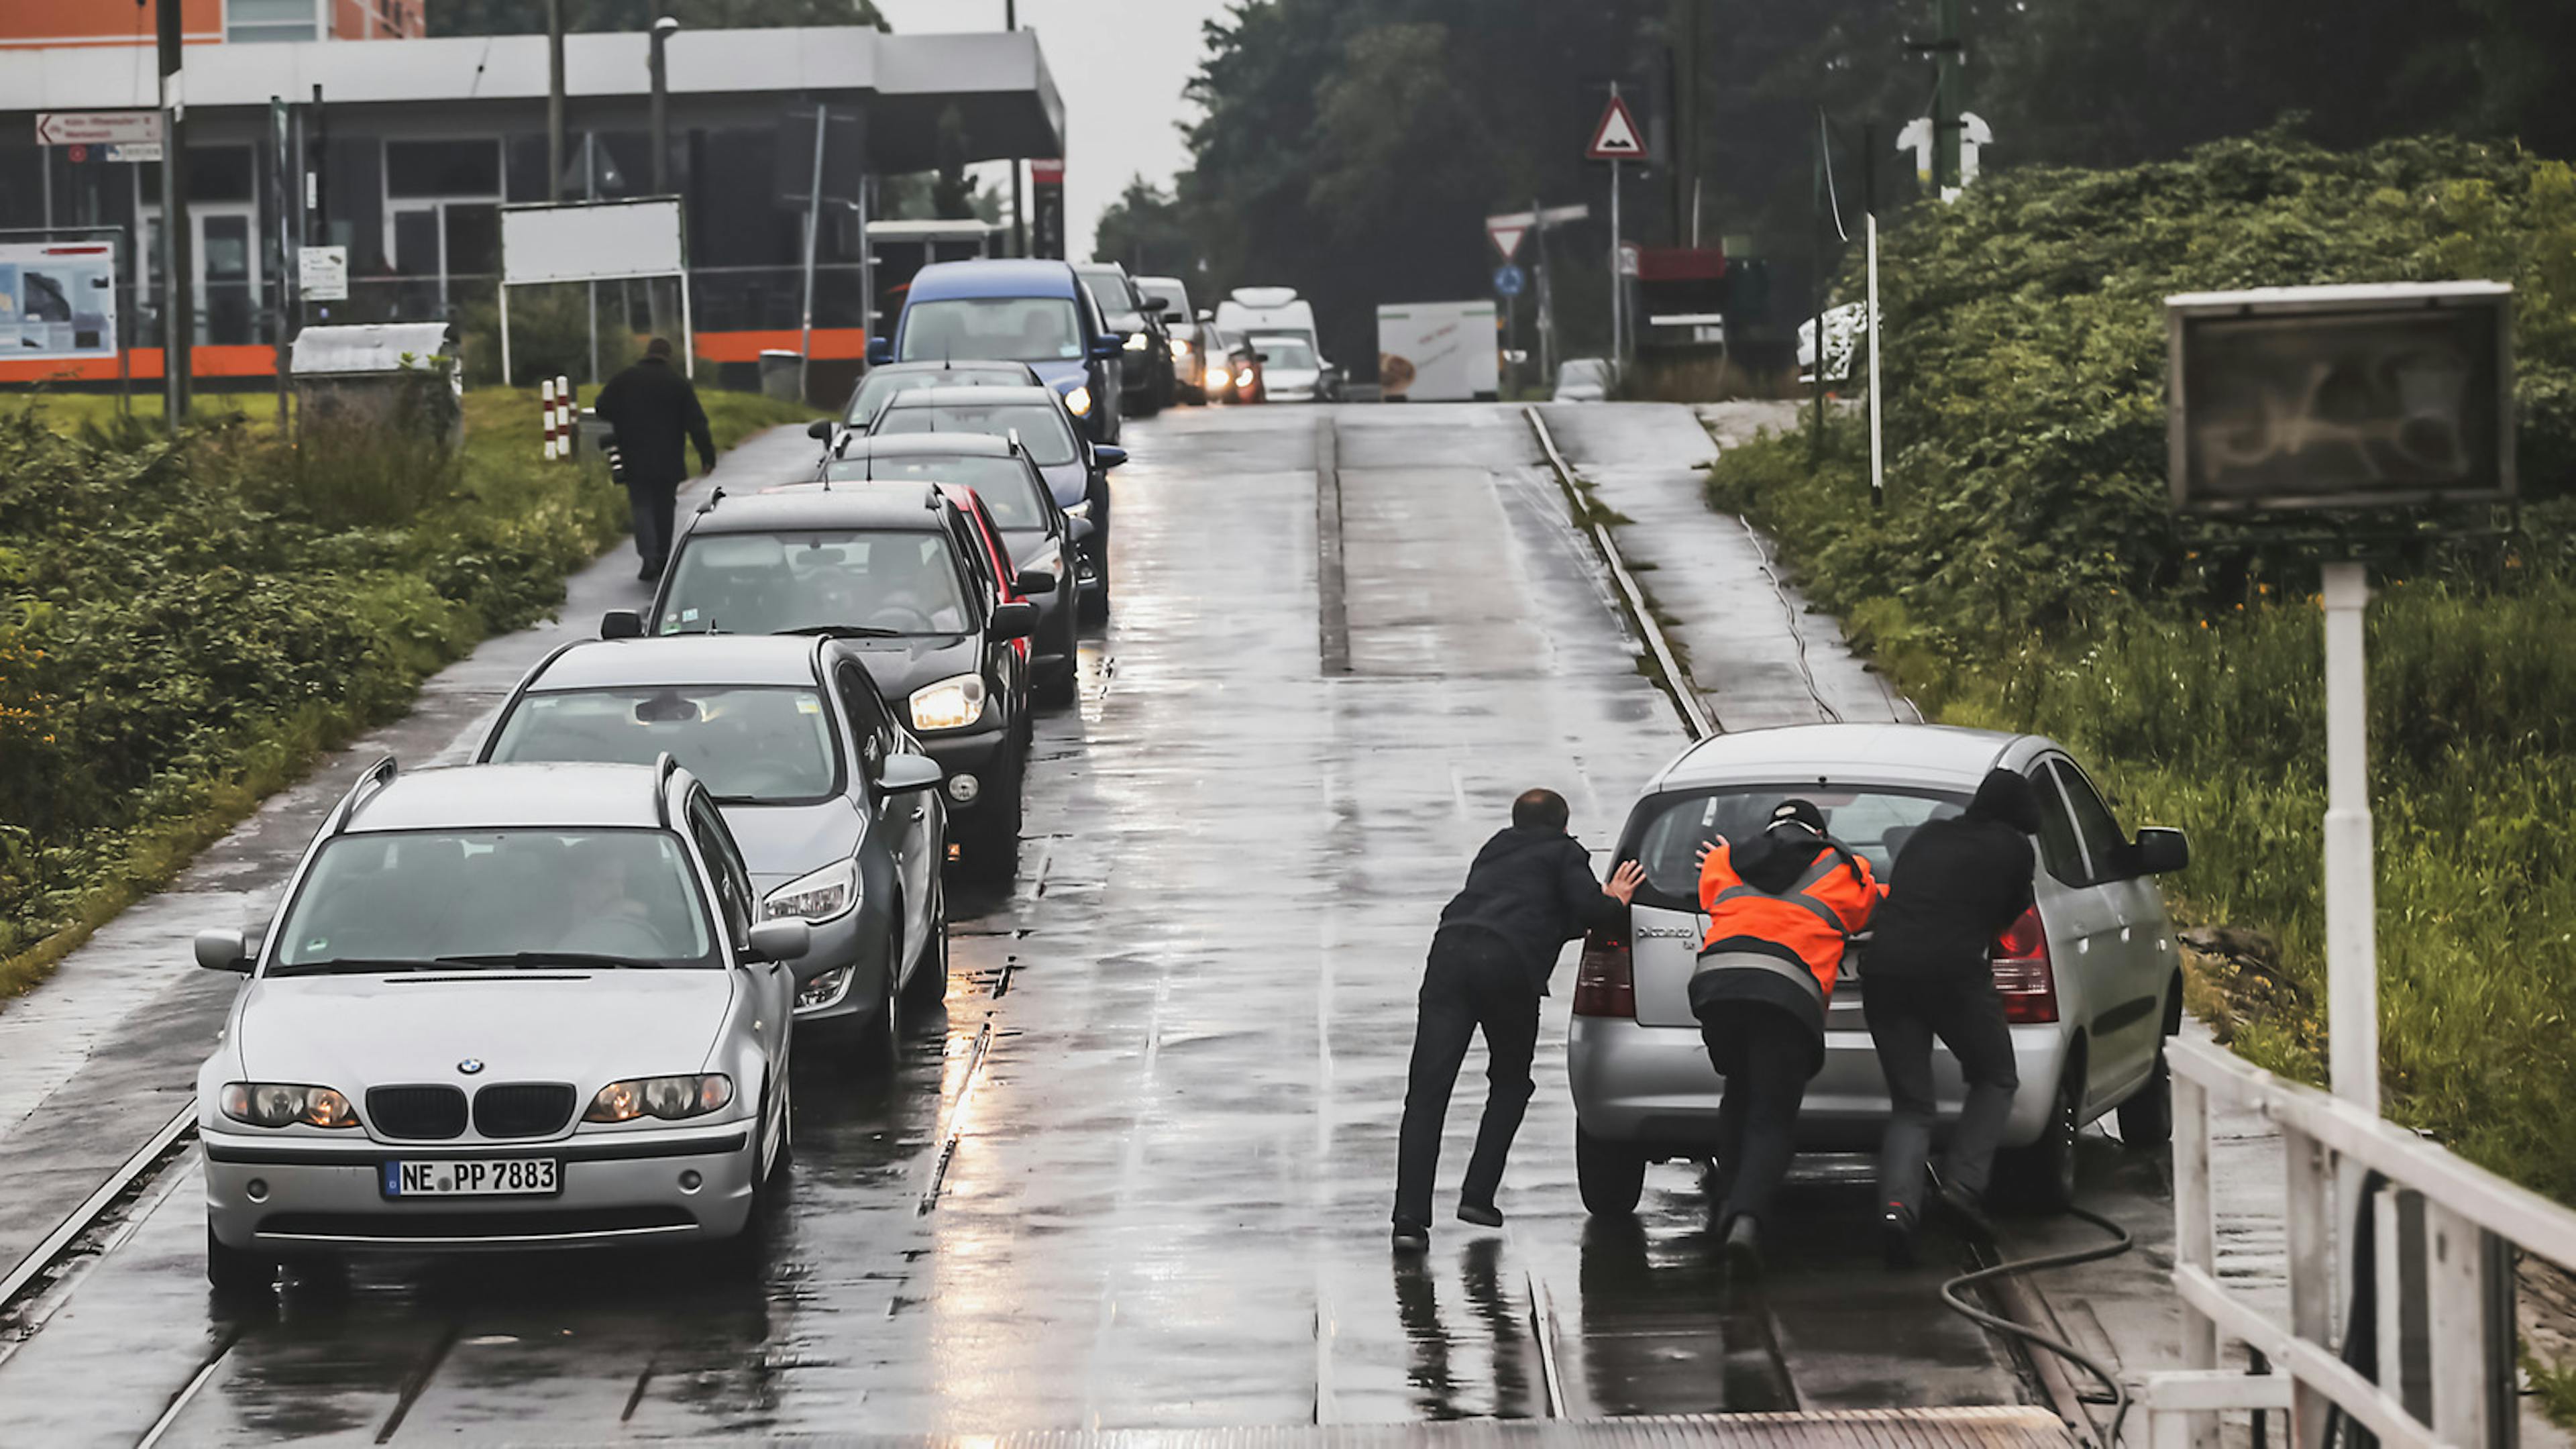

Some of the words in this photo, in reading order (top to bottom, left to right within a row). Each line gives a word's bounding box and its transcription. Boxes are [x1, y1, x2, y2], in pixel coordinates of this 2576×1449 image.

[403, 1165, 434, 1190] NE
[454, 1164, 485, 1190] PP
[493, 1162, 554, 1189] 7883
